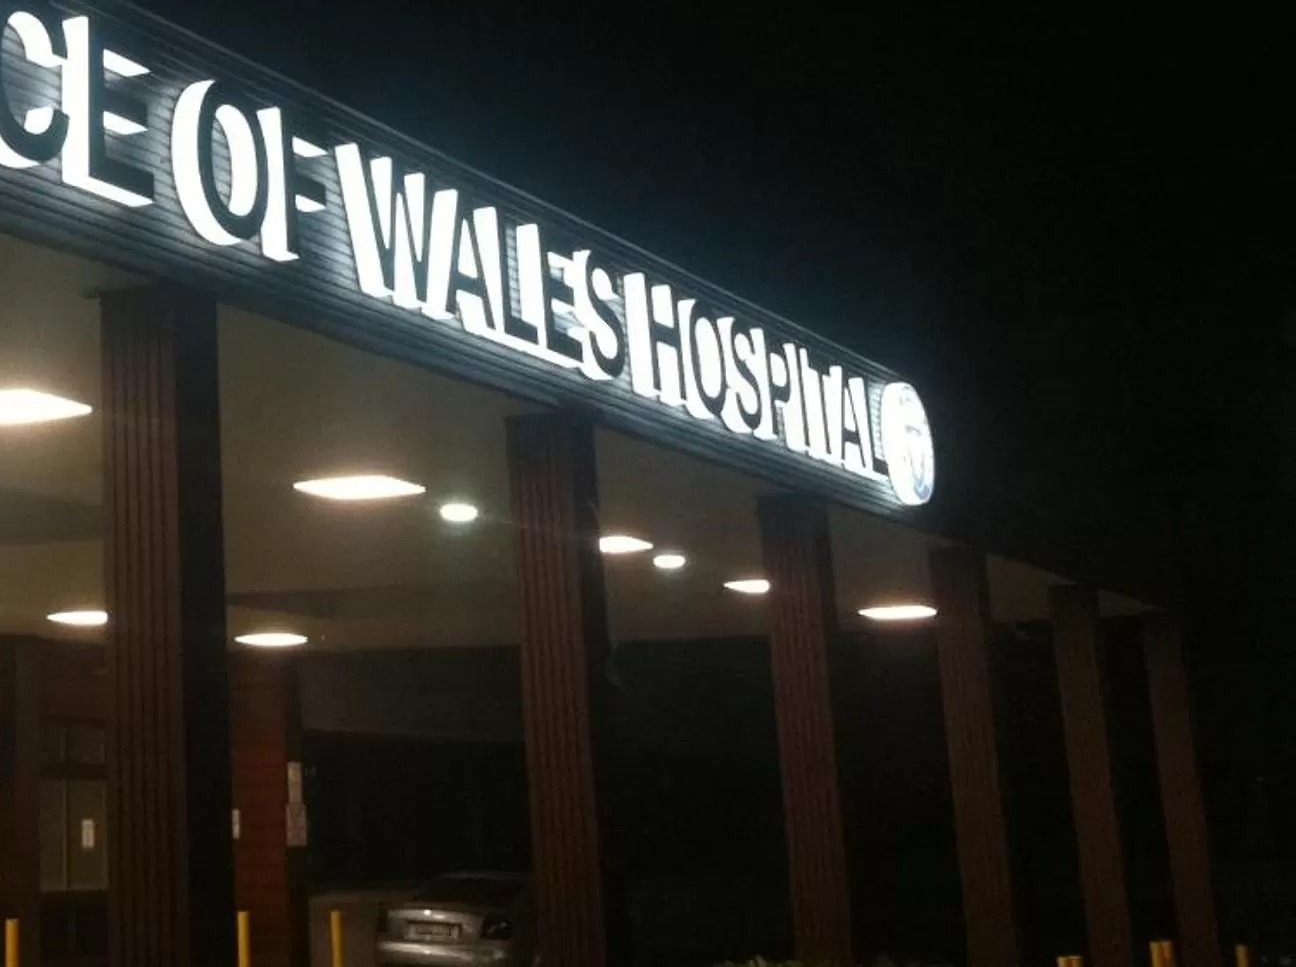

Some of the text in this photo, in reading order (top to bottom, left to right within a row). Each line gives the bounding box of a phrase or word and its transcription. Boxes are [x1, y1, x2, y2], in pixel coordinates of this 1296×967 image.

[170, 79, 328, 263] OF
[333, 142, 625, 381] WALES
[623, 272, 890, 483] HOSPITAL
